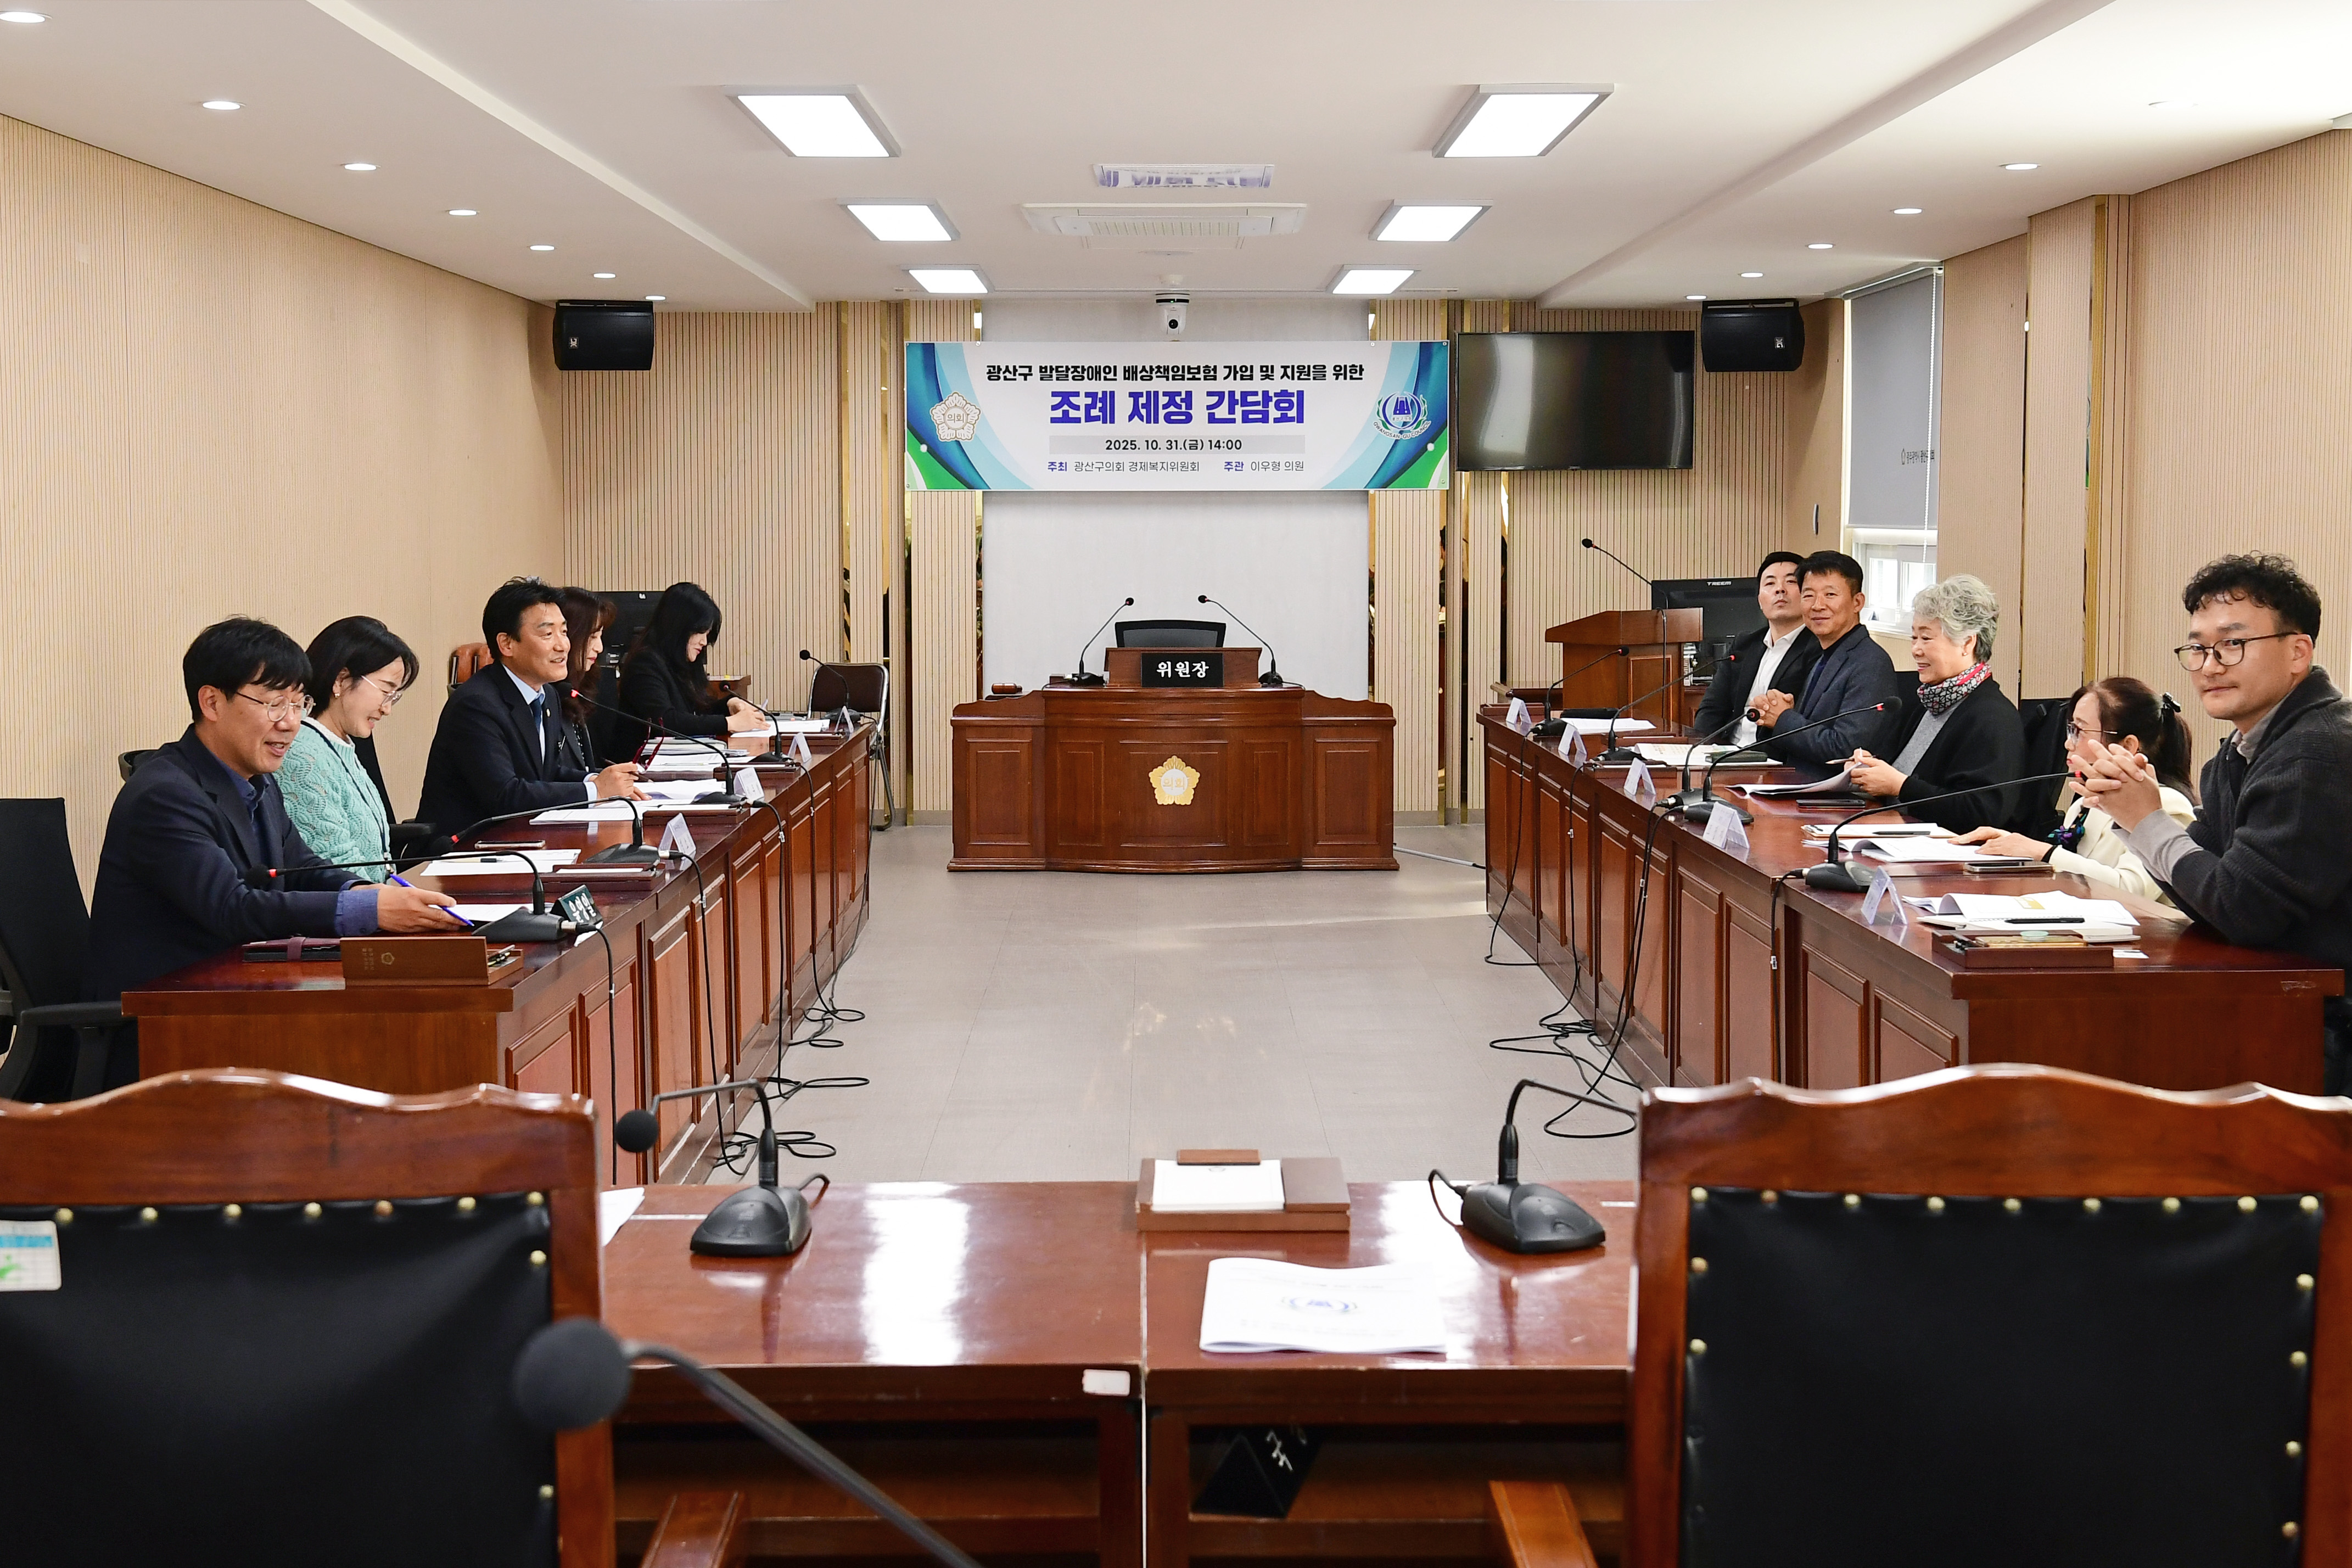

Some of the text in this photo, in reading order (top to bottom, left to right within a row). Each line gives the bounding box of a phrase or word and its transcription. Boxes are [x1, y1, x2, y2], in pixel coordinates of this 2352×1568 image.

[986, 364, 1364, 381] 광산구 발달장애인 배상책임보험 가입 및 지원을 위한
[1050, 389, 1304, 424] 조례 제정 간담회
[947, 413, 964, 423] 의회
[1411, 421, 1431, 437] COUNCIL
[1105, 439, 1242, 451] 2025. 10. 31.(금) 14:00
[1048, 461, 1200, 472] 주최 광산구의회 경제복지위원회
[1224, 461, 1304, 472] 주관 이우형 의원
[1156, 660, 1209, 678] 위원장
[568, 892, 597, 923] 윤영일
